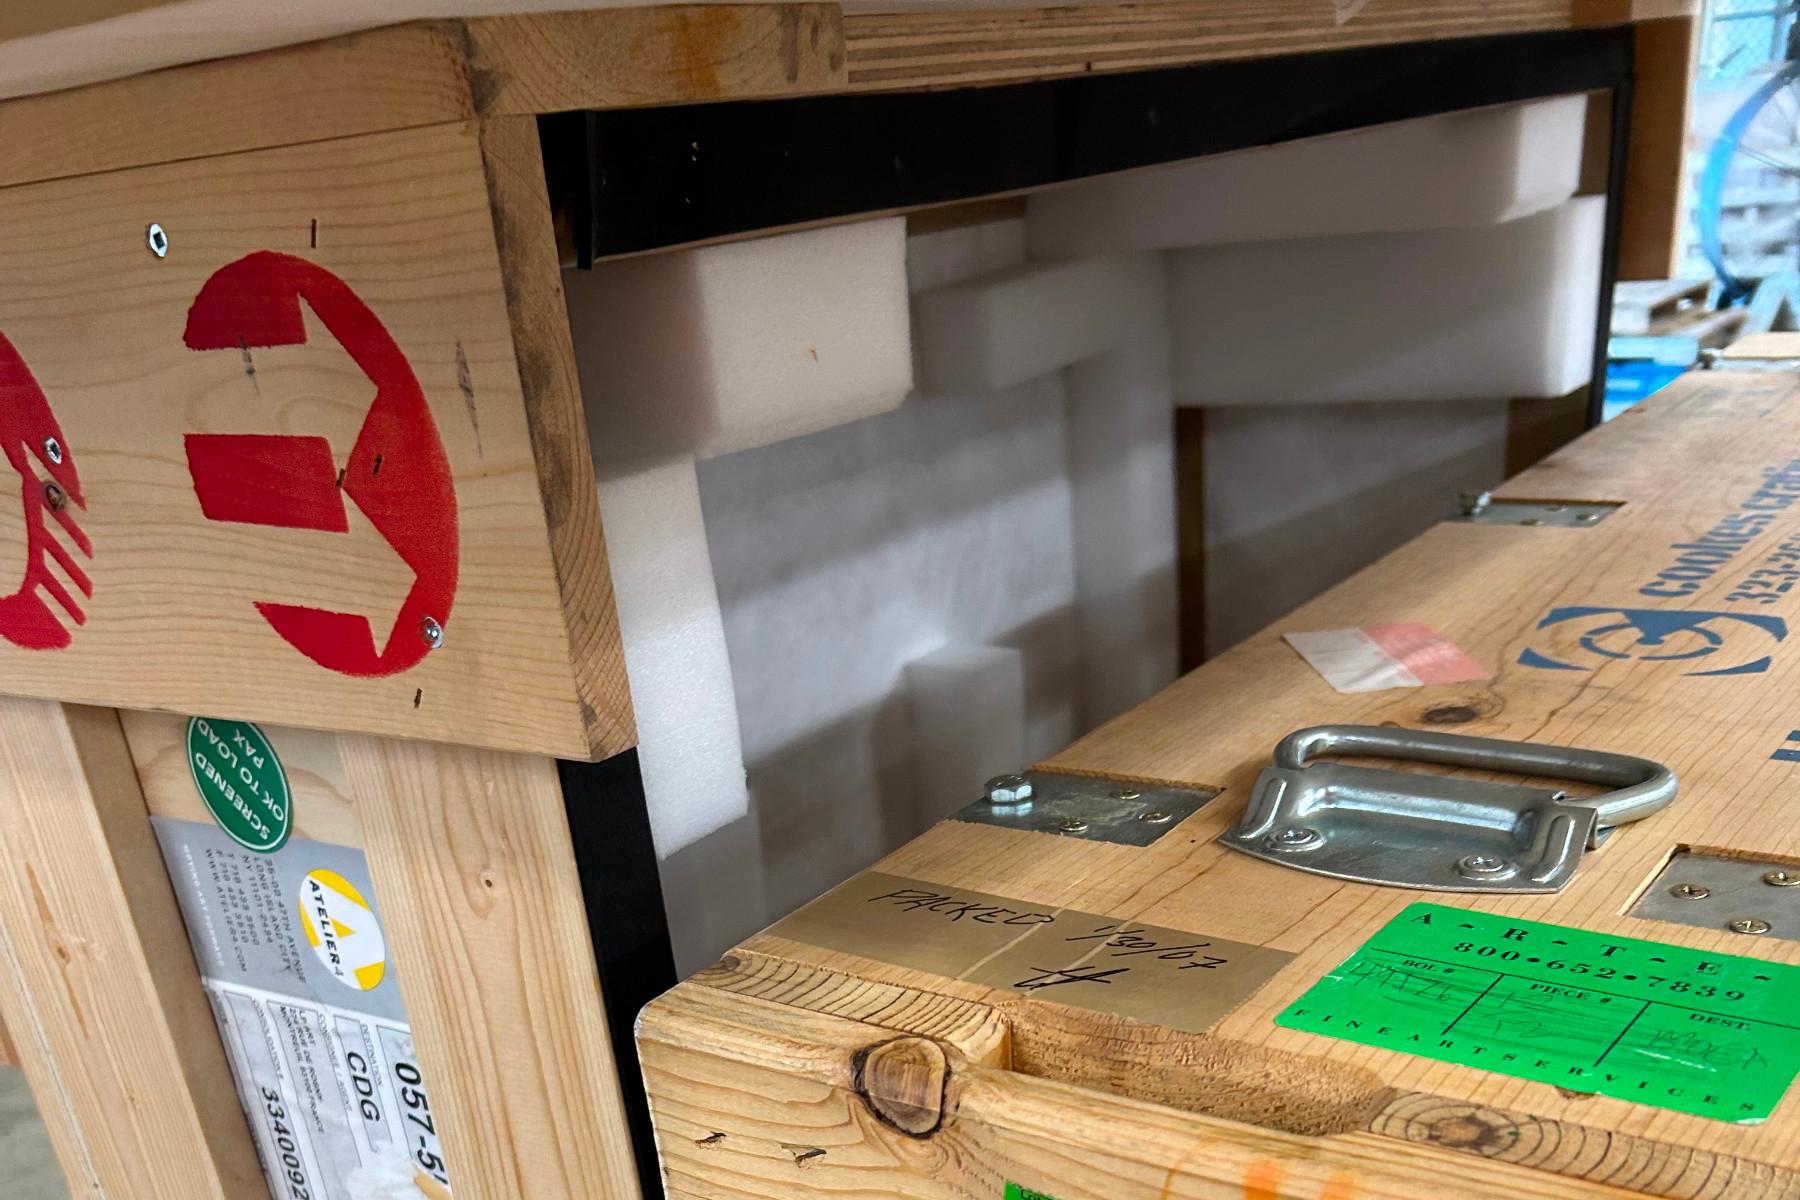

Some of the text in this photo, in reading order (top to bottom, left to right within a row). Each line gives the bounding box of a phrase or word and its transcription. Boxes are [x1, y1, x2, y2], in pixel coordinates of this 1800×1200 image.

[198, 719, 284, 821] OK TO LOAD
[233, 728, 264, 769] PAX
[195, 752, 270, 840] SCREENED
[309, 880, 344, 976] ATELIER4
[868, 889, 1055, 926] PACKED
[1401, 959, 1440, 973] BOL
[1529, 983, 1591, 1001] PIECE
[347, 1051, 381, 1122] CDG
